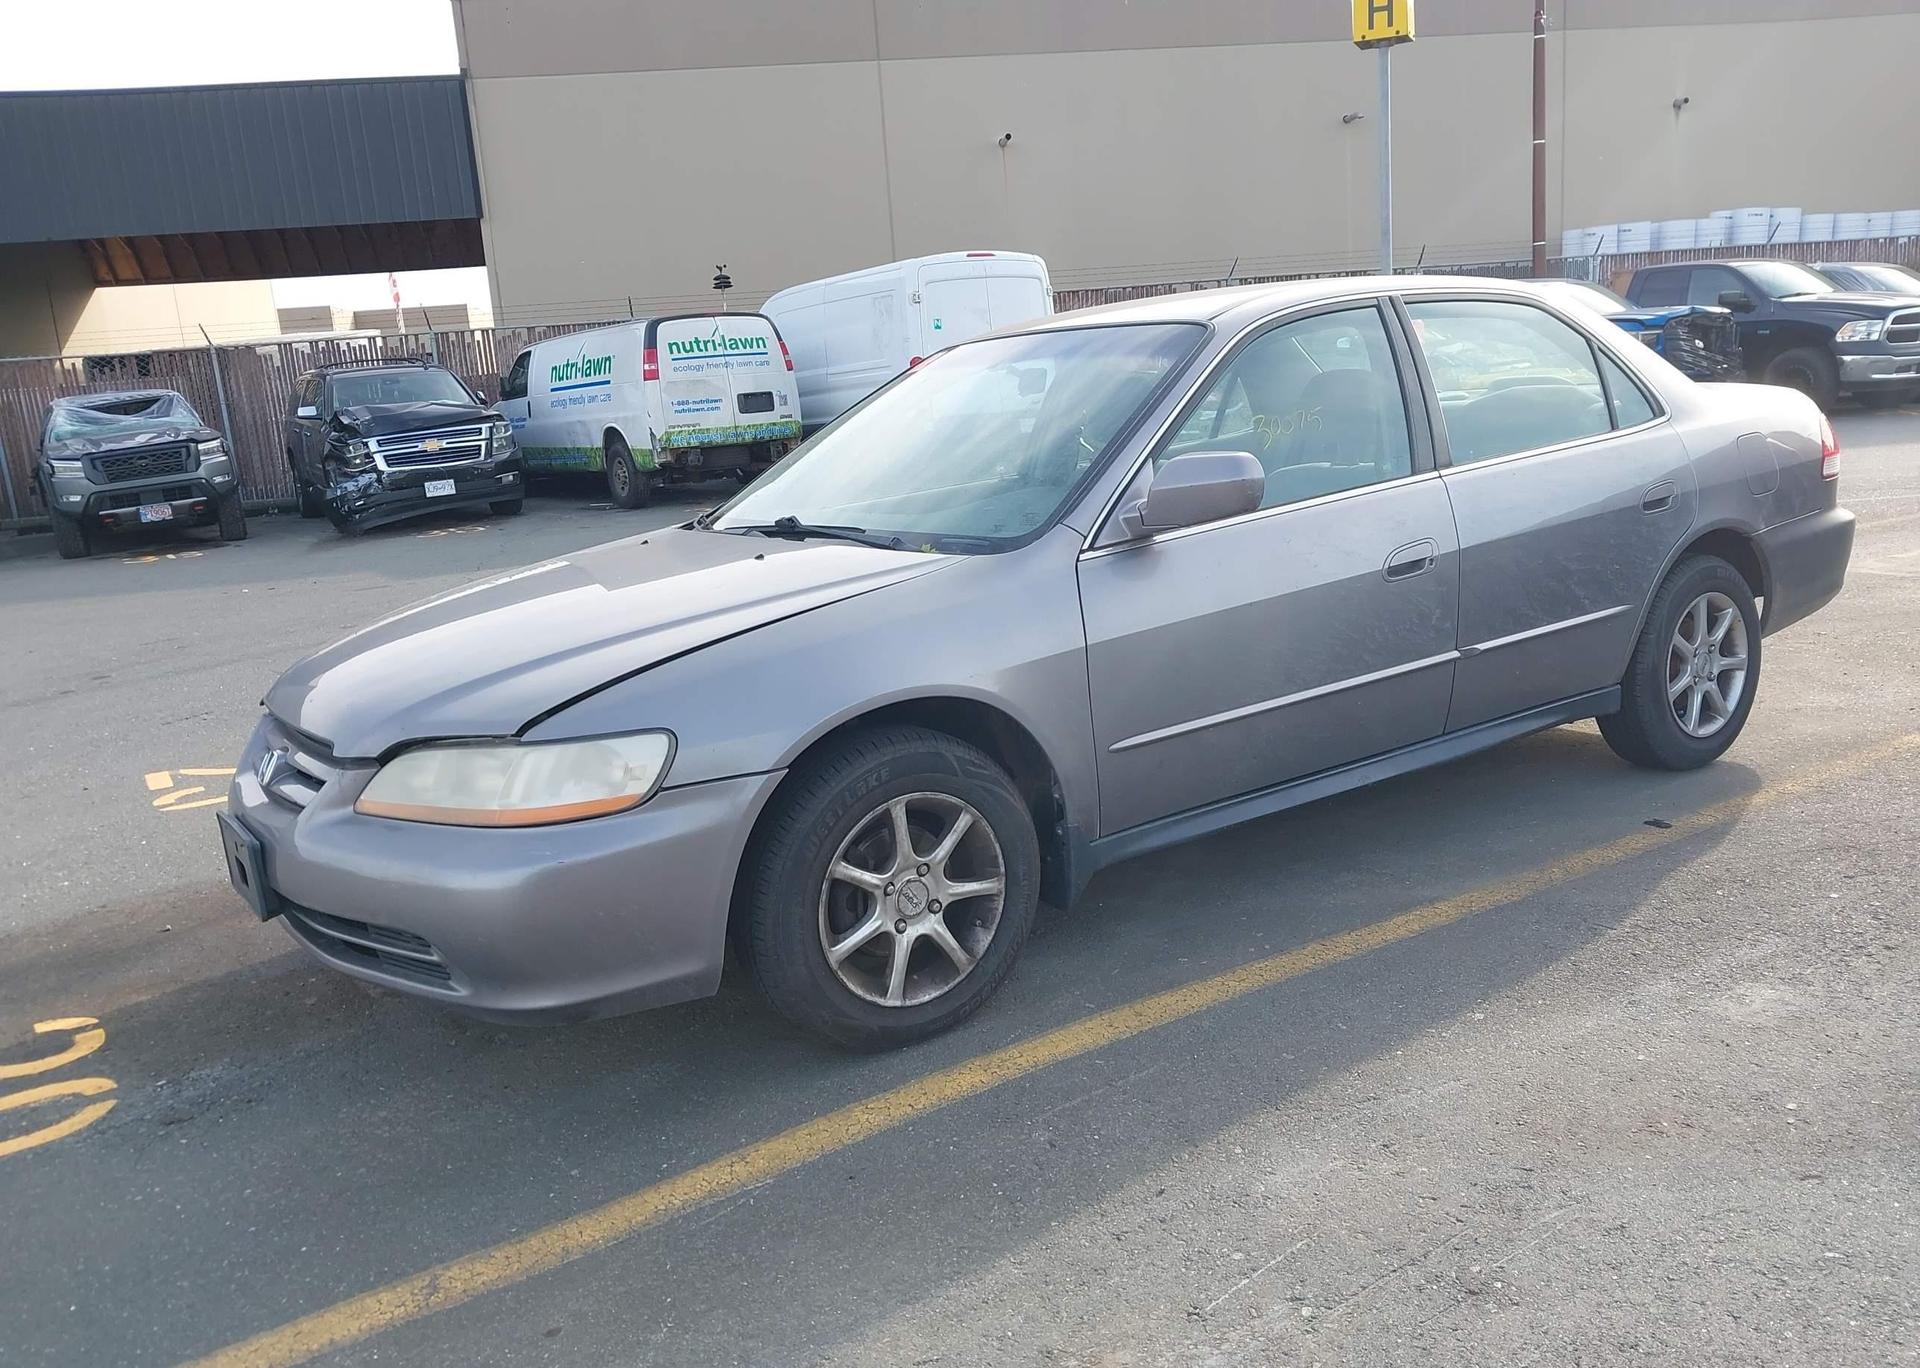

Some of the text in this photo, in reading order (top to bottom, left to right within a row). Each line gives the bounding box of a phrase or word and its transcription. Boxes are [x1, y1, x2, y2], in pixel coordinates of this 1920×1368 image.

[1368, 0, 1393, 30] H
[673, 358, 770, 373] ecology friendly lawn care
[600, 393, 612, 402] care
[671, 397, 723, 407] 1-888-nutrilawn
[674, 405, 721, 415] nutrilawn.com
